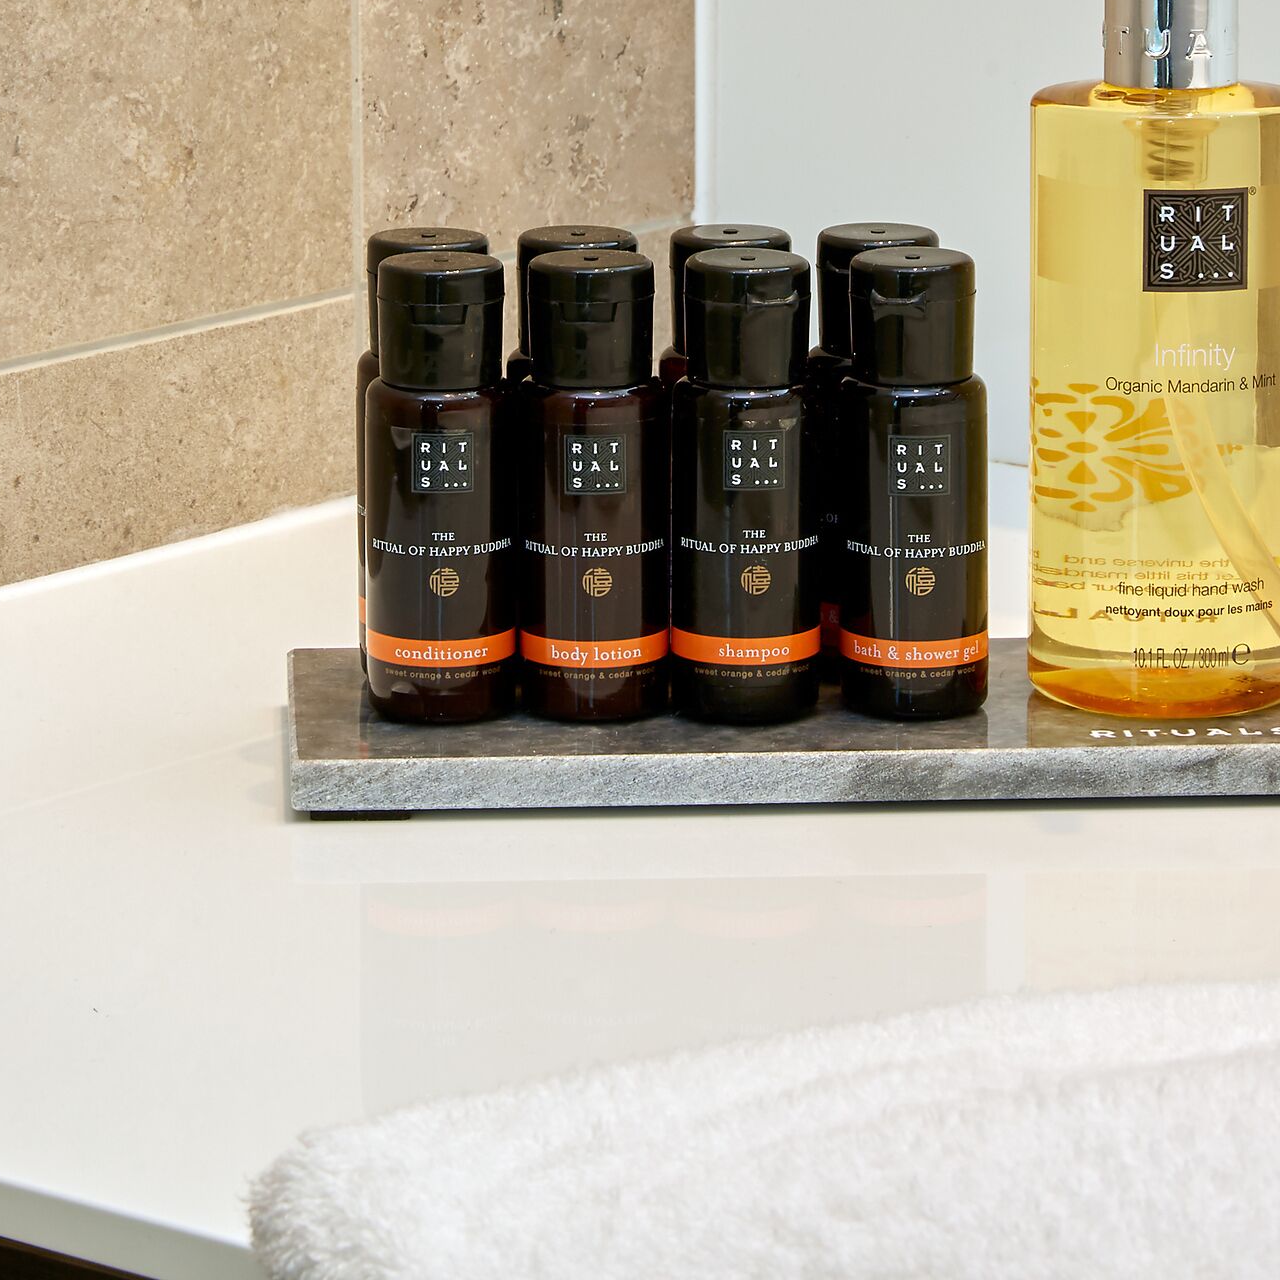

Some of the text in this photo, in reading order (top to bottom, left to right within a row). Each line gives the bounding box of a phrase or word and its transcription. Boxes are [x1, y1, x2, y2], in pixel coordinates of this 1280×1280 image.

[1154, 342, 1236, 370] Infinity
[1105, 372, 1277, 395] Organic Mandarin & Mint
[431, 532, 456, 541] THE
[583, 532, 608, 542] THE
[742, 529, 766, 539] THE
[907, 533, 931, 543] THE
[372, 537, 512, 557] RITUAL OF HAPPY BUDDHA
[525, 538, 664, 557] RITUAL OF HAPPY BUDDHA
[680, 535, 819, 554] RITUAL OF HAPPY BUDDHA
[846, 539, 986, 559] RITUAL OF HAPPY BUDDHA
[1118, 581, 1144, 596] fine
[1148, 582, 1187, 600] liquid
[1192, 581, 1228, 596] hand
[1232, 577, 1265, 593] wash
[1105, 600, 1273, 619] nettoyant doux pour les mains
[394, 646, 489, 661] conditioner
[550, 645, 642, 666] body lotion
[718, 643, 790, 662] shampoo
[853, 640, 980, 661] bath & shower gel
[1133, 647, 1153, 668] 10.1
[1156, 647, 1171, 669] FL.
[1174, 647, 1190, 669] OZ.
[1198, 647, 1217, 669] 300
[1219, 645, 1229, 668] ml
[409, 671, 442, 681] orange
[444, 670, 452, 680] &
[454, 669, 479, 679] cedar
[563, 671, 596, 682] orange
[598, 671, 606, 680] &
[608, 669, 634, 679] cedar
[720, 669, 754, 680] orange
[756, 669, 764, 678] &
[765, 667, 791, 677] cedar
[884, 669, 918, 680] orange
[920, 669, 927, 678] &
[929, 668, 955, 678] cedar
